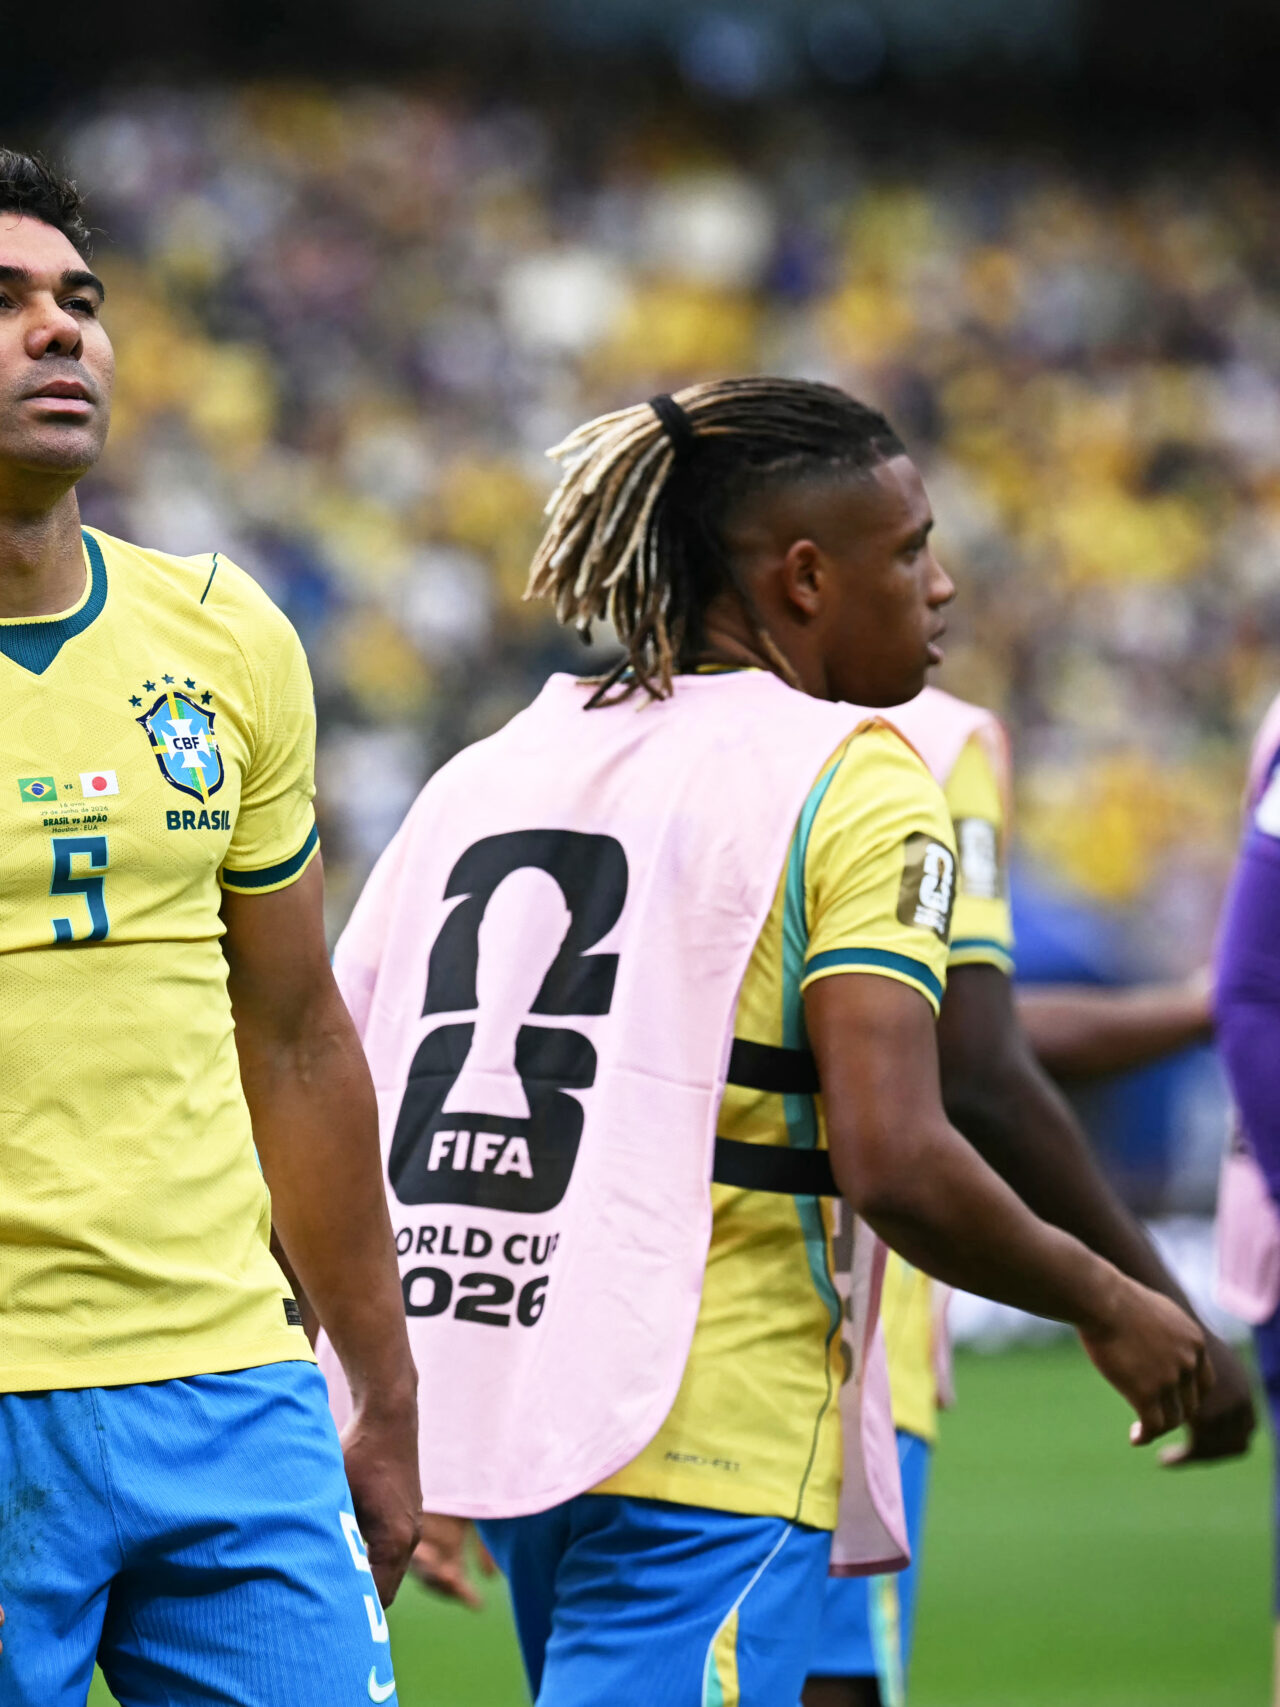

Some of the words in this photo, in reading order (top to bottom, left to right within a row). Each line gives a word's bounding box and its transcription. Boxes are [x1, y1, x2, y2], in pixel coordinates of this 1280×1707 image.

[173, 737, 201, 750] CBF
[83, 813, 108, 824] JAPÃO
[166, 810, 230, 831] BRASIL
[49, 836, 110, 943] 5
[427, 1129, 533, 1180] FIFA
[396, 1225, 493, 1258] ORLD
[402, 1266, 549, 1328] 026
[339, 1511, 389, 1643] 5
